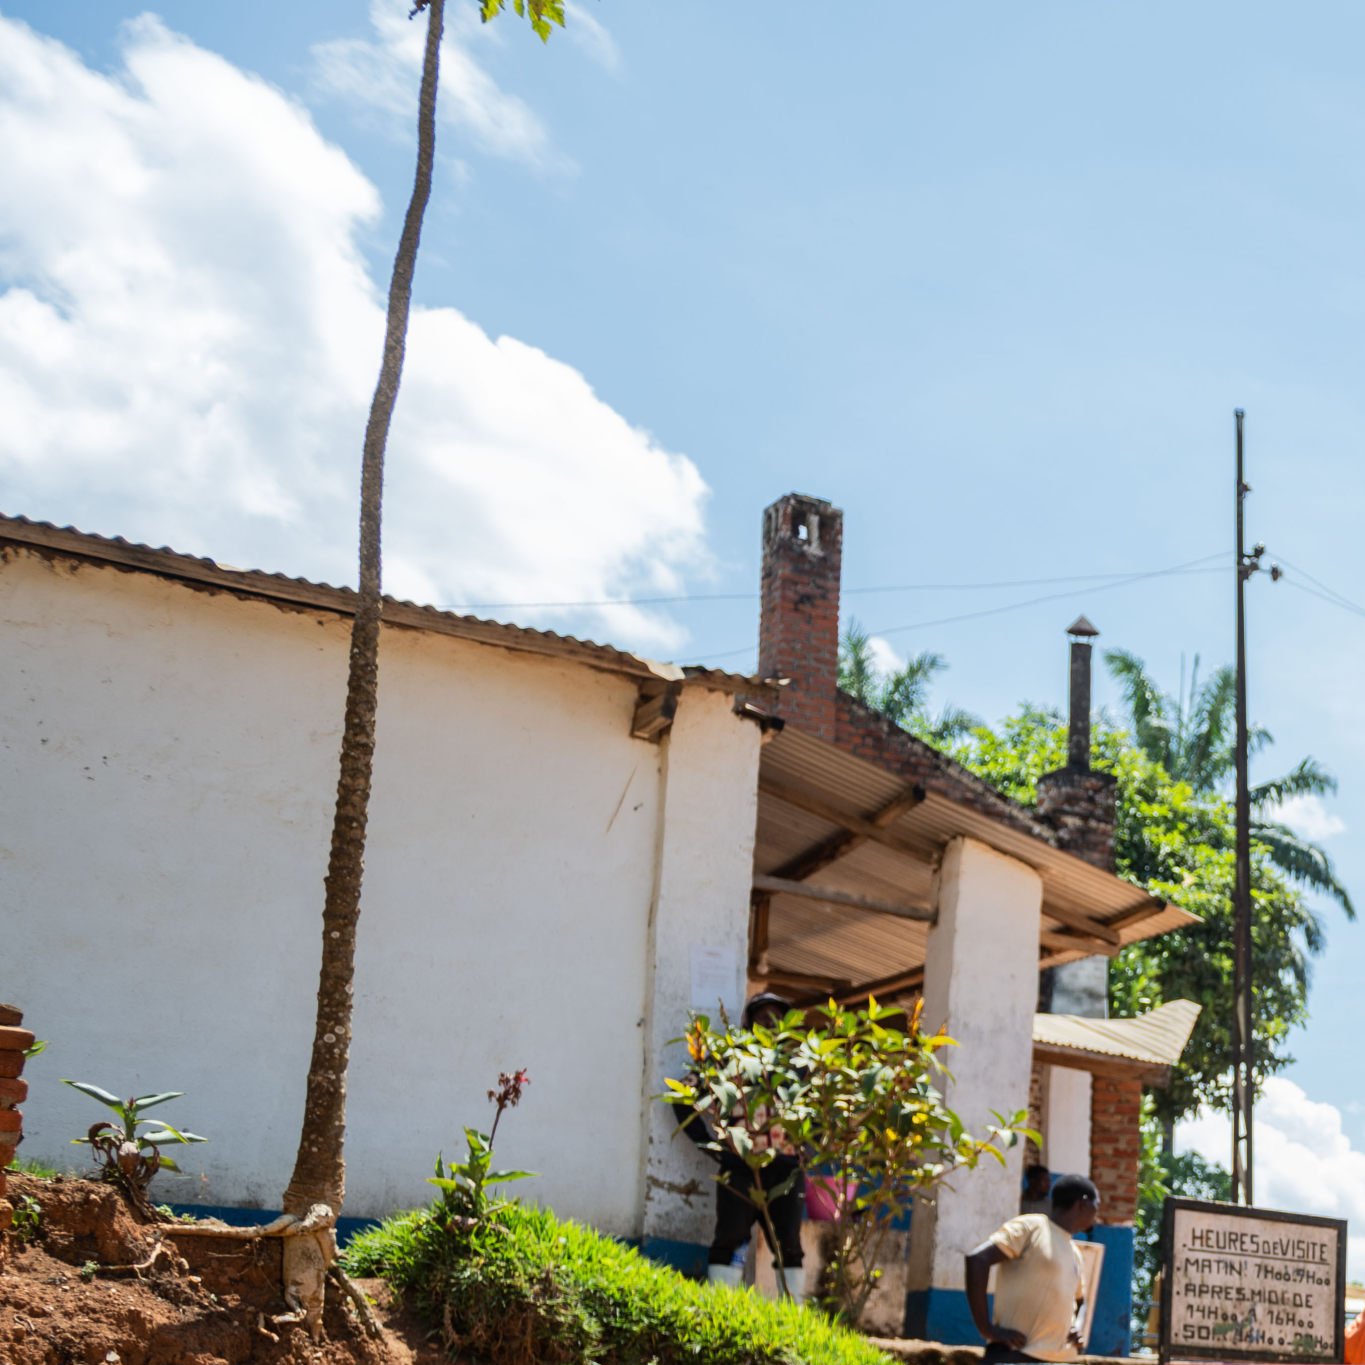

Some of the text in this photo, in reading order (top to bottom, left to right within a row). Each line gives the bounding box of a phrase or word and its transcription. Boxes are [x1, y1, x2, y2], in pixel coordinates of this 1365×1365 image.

[1191, 1227, 1329, 1262] HEURES DE VISITE
[1292, 1292, 1313, 1309] DE
